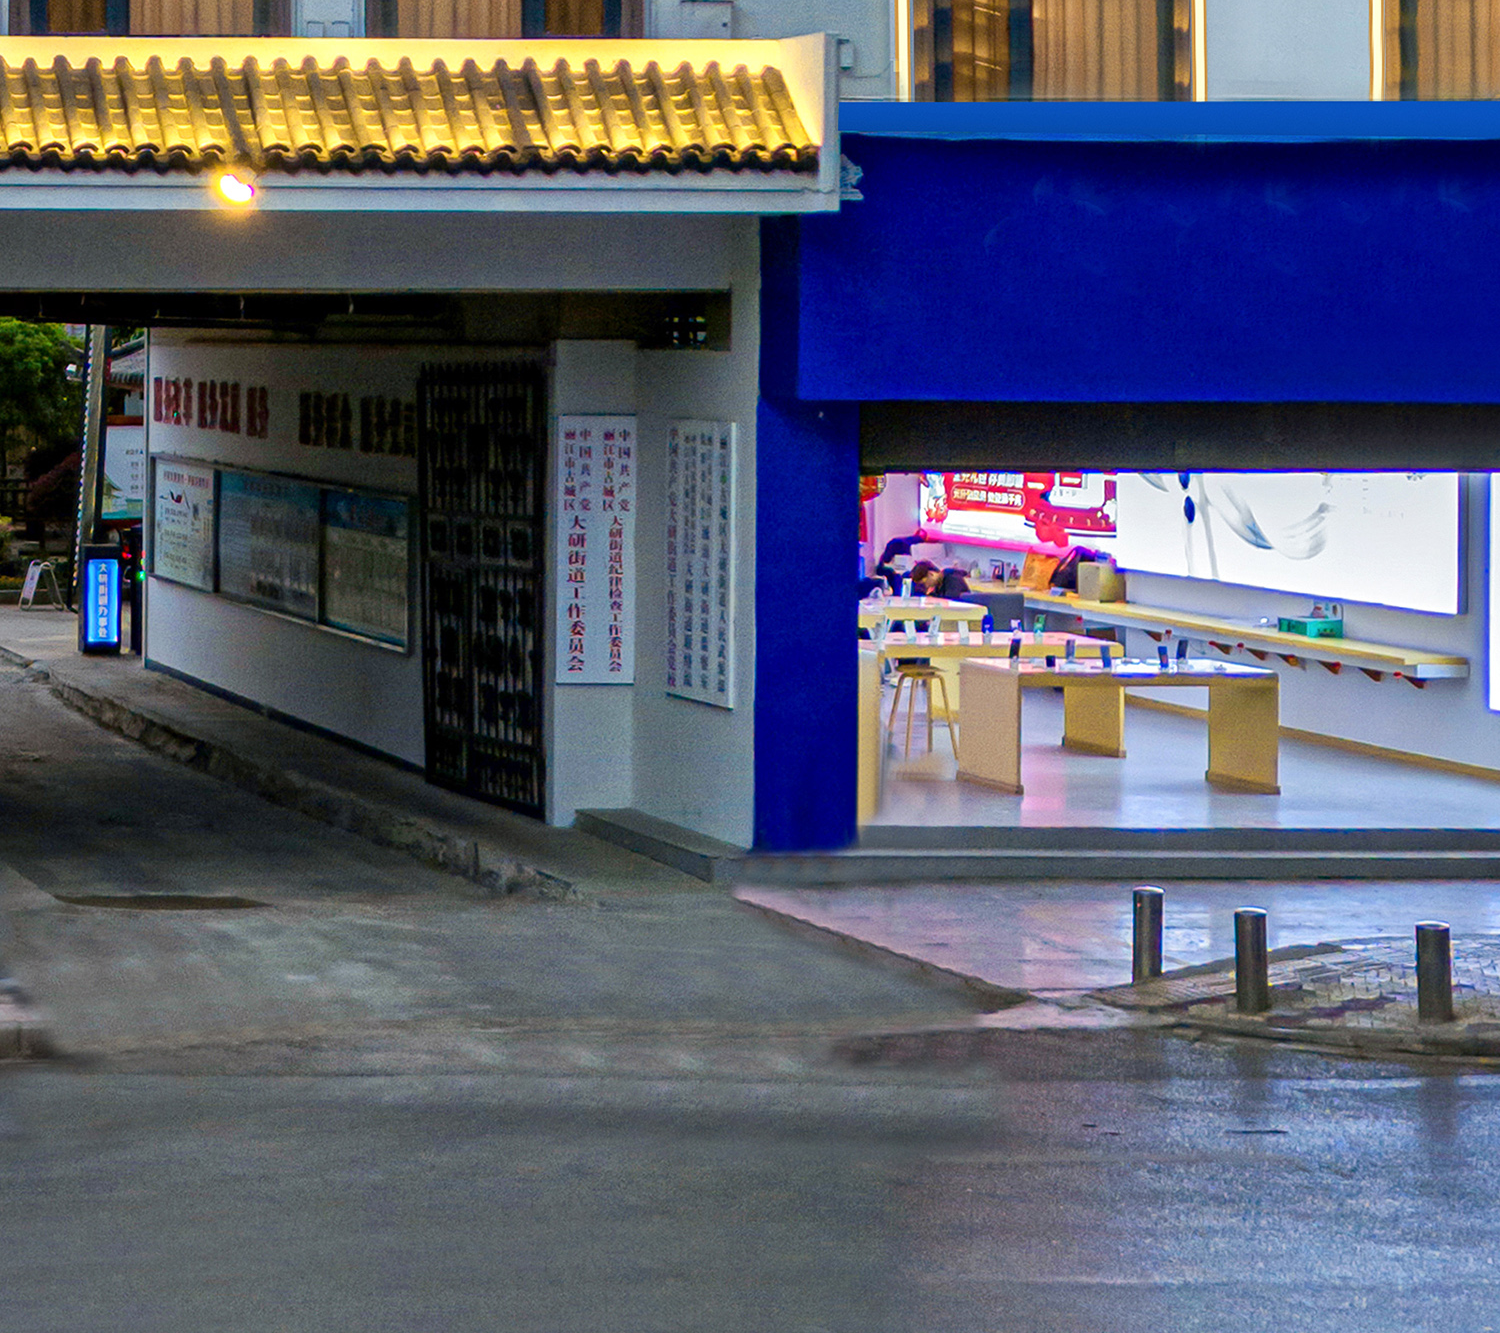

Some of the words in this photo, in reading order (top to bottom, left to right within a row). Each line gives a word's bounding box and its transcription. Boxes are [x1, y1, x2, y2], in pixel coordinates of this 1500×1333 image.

[580, 429, 592, 511] 中国共产党
[618, 429, 631, 511] 中国共产党
[567, 515, 587, 672] 大研街道工作委员会
